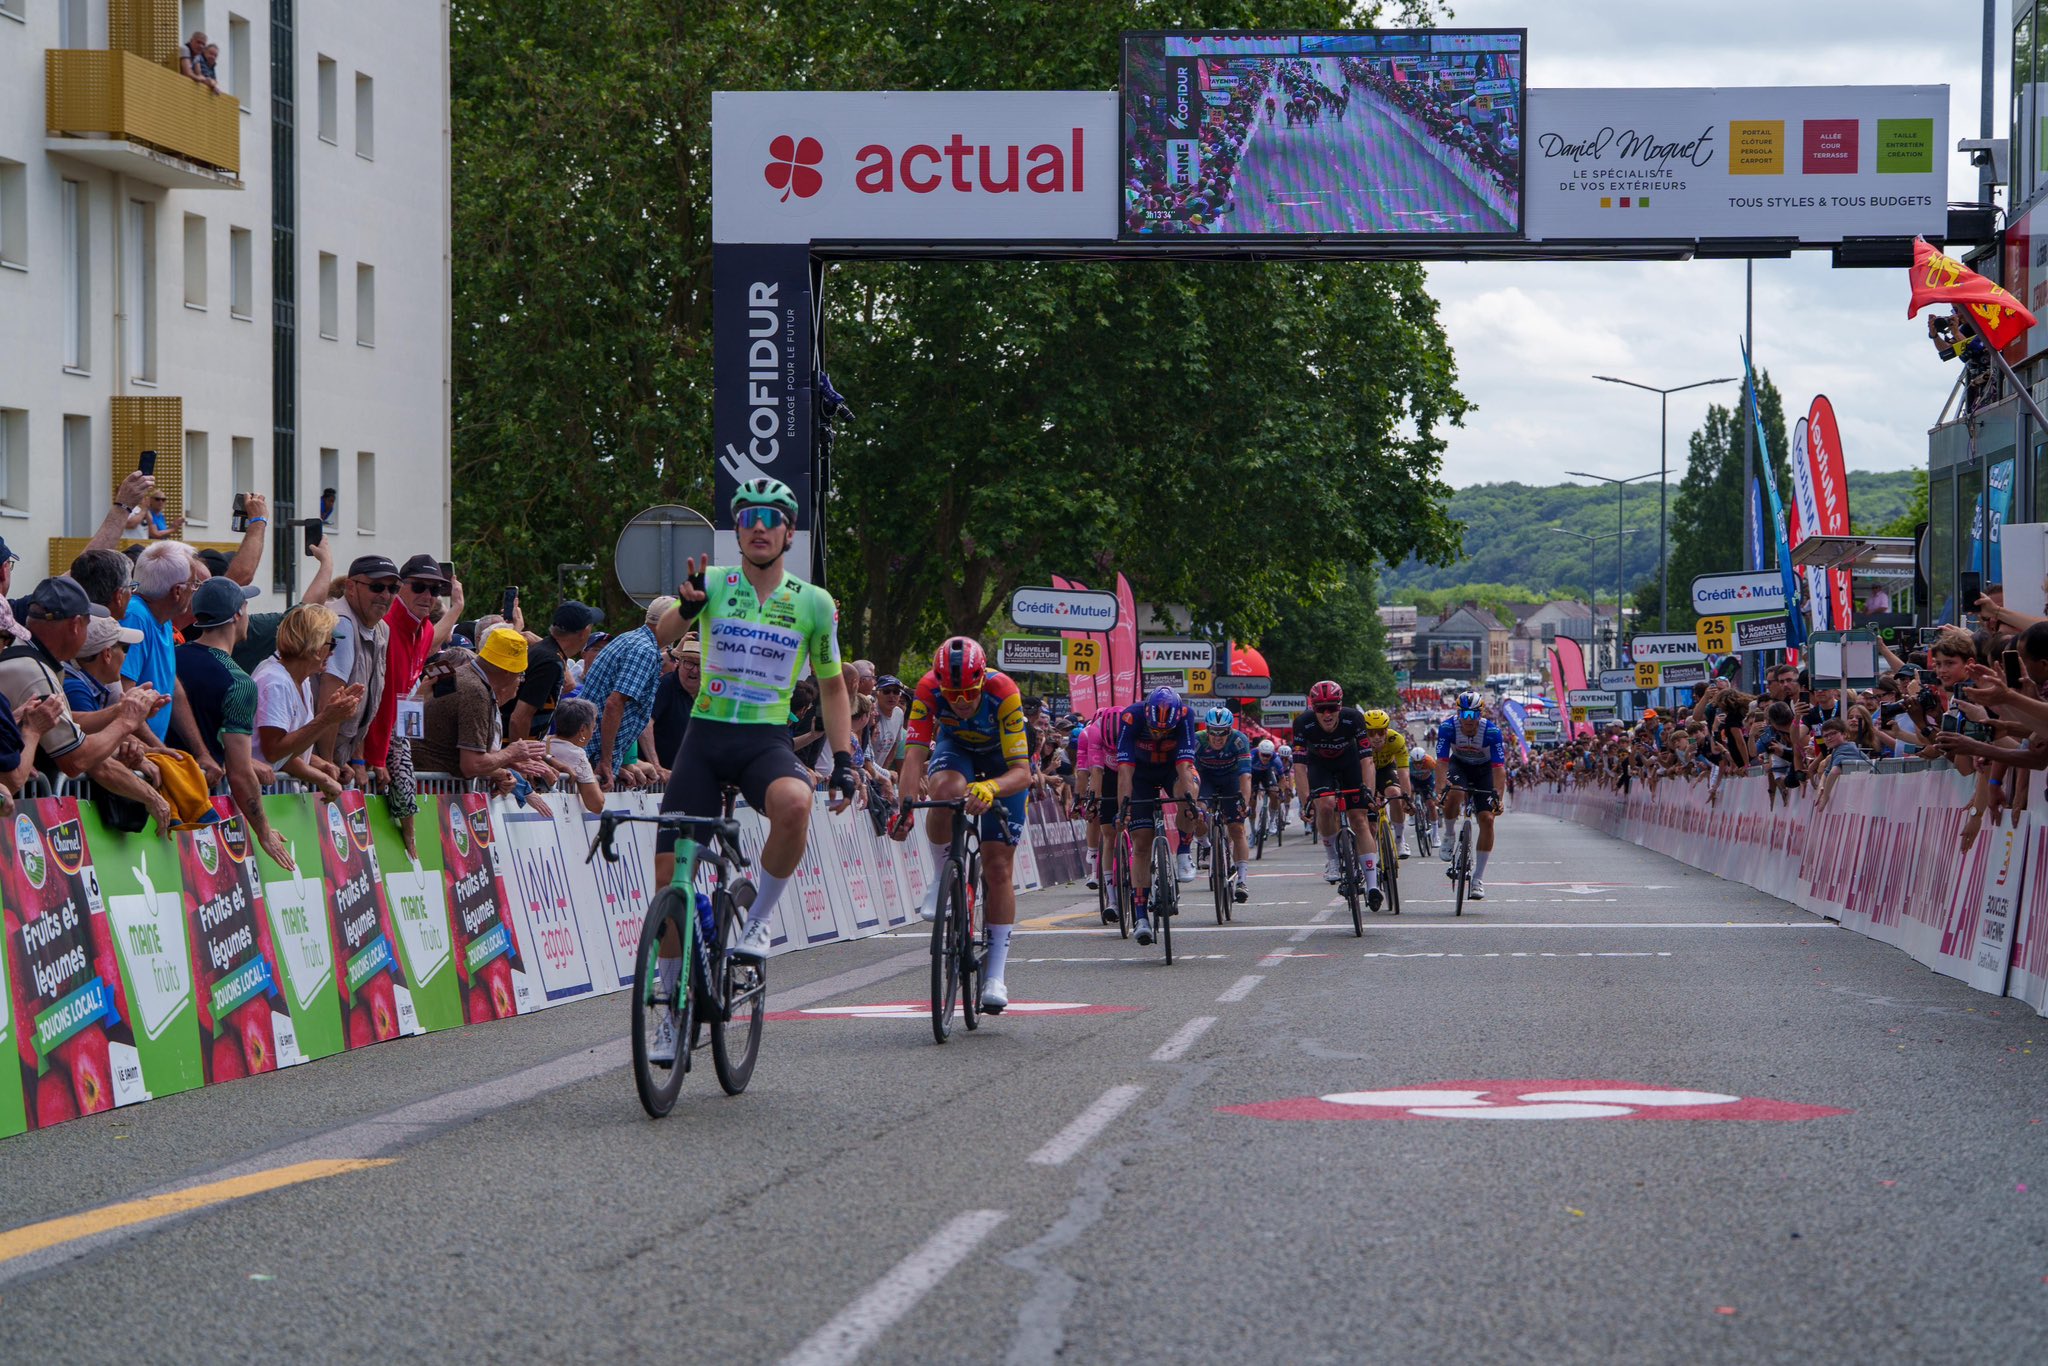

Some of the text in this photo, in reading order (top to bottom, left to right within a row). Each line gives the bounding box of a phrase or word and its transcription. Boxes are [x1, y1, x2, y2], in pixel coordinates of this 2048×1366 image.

[1177, 67, 1189, 121] COFIDUR
[855, 128, 1084, 193] actual
[1177, 144, 1189, 184] ENNE
[1539, 126, 1714, 173] Daniel Moquet
[1560, 180, 1687, 191] DE VOS EXTÉRIEURS
[1573, 168, 1673, 179] LE SPÉCIALISTE
[1729, 196, 1932, 207] TOUS STYLES & TOUS BUDGETS
[749, 282, 779, 464] COFIDUR
[787, 309, 796, 437] ENGAGÉ POUR LE FUTUR
[1697, 585, 1784, 602] Crédit Mutu
[1017, 601, 1111, 617] Crédit Mutuel
[723, 625, 800, 649] DECATHLON
[1703, 620, 1725, 634] 25
[1748, 623, 1786, 633] NOUVELLE
[1749, 628, 1786, 638] AGRICULTU
[716, 641, 786, 661] CMA CGM
[821, 633, 831, 665] actual
[1073, 642, 1094, 657] 25
[1634, 643, 1701, 654] MAYENN
[1707, 638, 1723, 649] m
[745, 669, 767, 678] RYSEL
[1075, 661, 1090, 672] m
[1192, 671, 1206, 681] 50
[1602, 676, 1623, 684] Crédit
[1639, 664, 1654, 675] 50
[1641, 677, 1653, 685] m
[1313, 741, 1349, 749] TUDOR
[90, 871, 99, 896] 6
[336, 869, 370, 913] Fruits et
[455, 863, 489, 903] Fruits et
[198, 882, 246, 932] Fruits et
[281, 905, 309, 936] MAINE
[400, 895, 428, 921] MAINE
[462, 898, 495, 935] légumes
[22, 897, 79, 955] Fruits et
[128, 923, 163, 956] MAINE
[343, 907, 376, 948] légumes
[419, 922, 442, 951] fruits
[208, 924, 253, 970] légumes
[300, 936, 324, 969] fruits
[540, 921, 574, 969] agglo
[33, 944, 86, 998] légumes
[151, 957, 180, 993] fruits
[214, 977, 242, 1011] JOUONS
[39, 1009, 72, 1044] JOUONS
